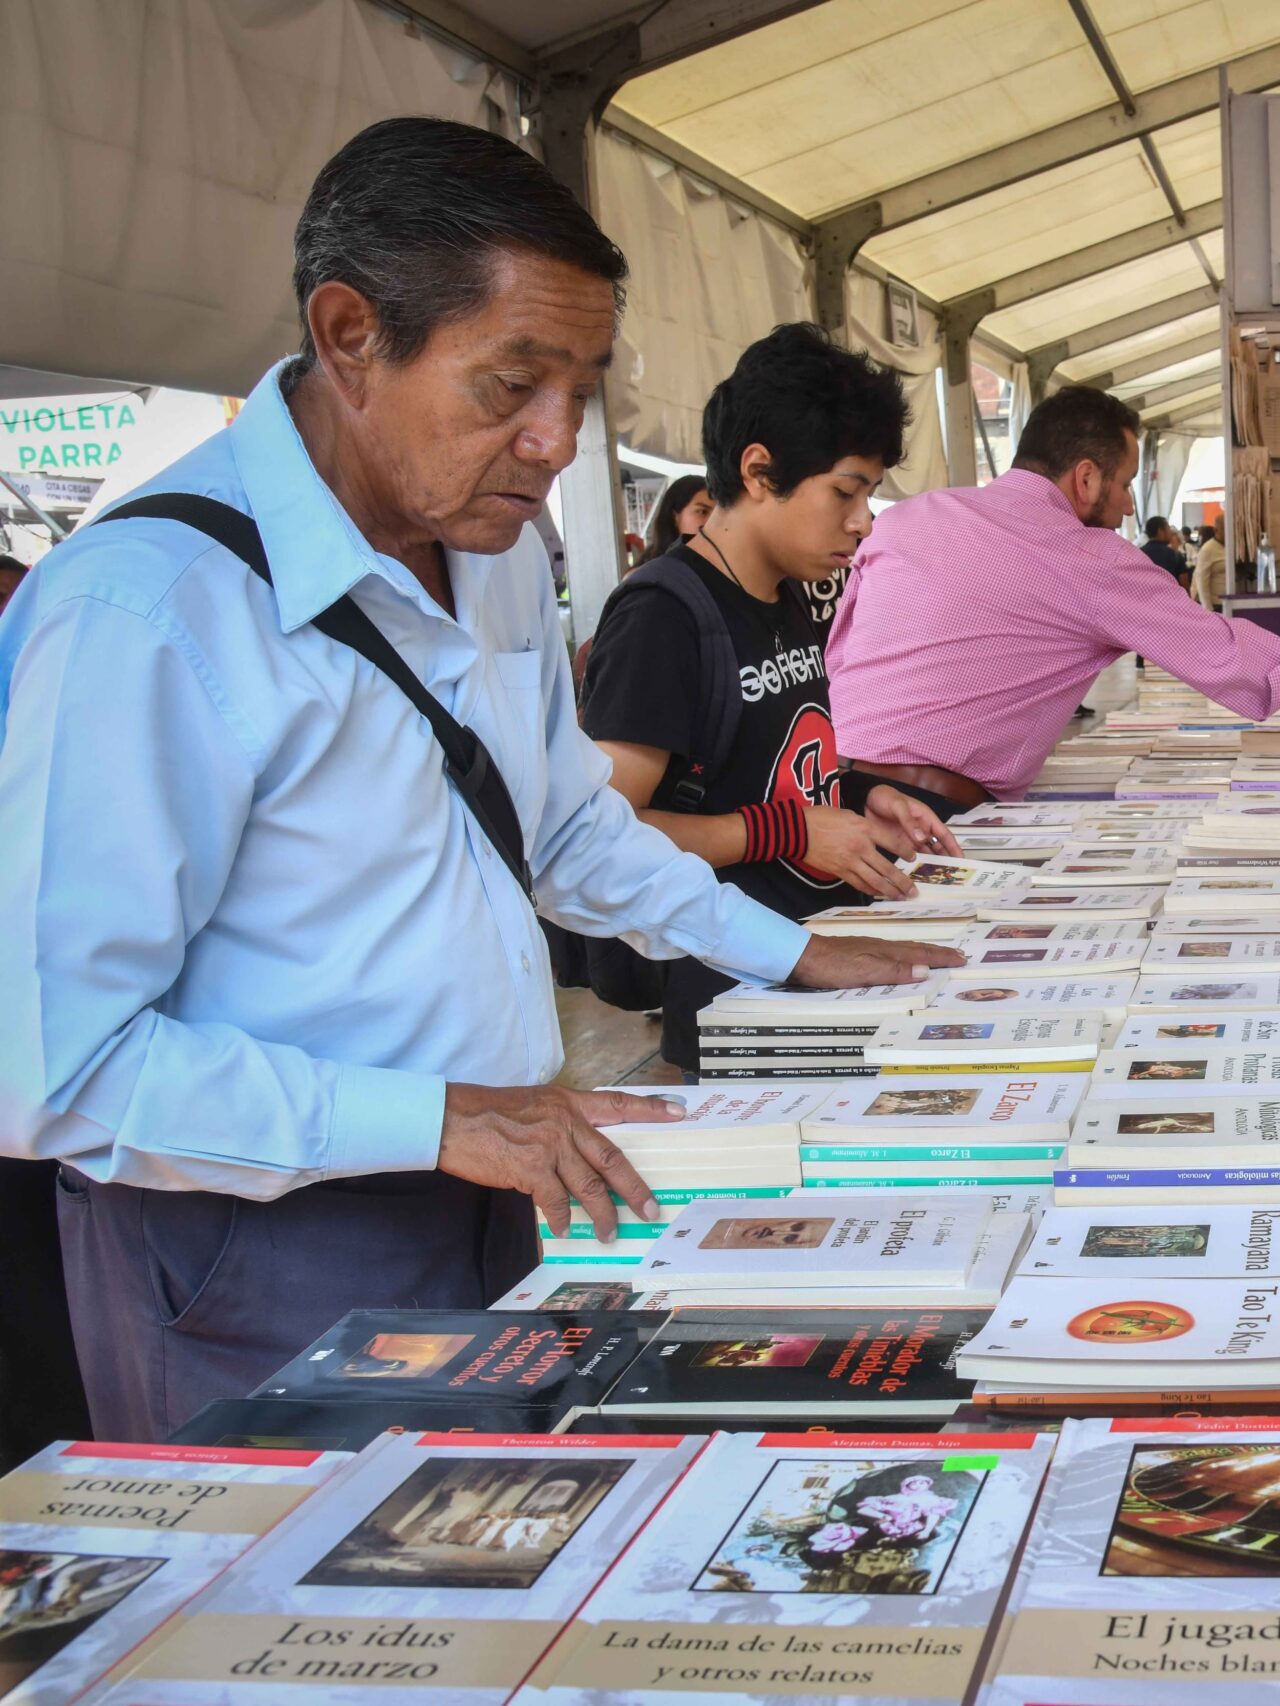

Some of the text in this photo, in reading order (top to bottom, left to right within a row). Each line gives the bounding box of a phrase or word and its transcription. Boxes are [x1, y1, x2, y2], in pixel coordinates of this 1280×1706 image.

[0, 404, 136, 434] VIOLETA
[18, 441, 123, 470] PARRA
[988, 1081, 1039, 1121] El Zarco
[931, 1149, 970, 1159] El Zarco
[1224, 1171, 1270, 1183] mitológicas
[880, 1209, 928, 1256] El profeta
[1215, 1286, 1279, 1355] Tao Te King
[486, 1326, 521, 1351] otros
[479, 1329, 556, 1385] Secreto y
[516, 1327, 594, 1387] El Horror
[848, 1333, 903, 1386] Tinieblas
[879, 1314, 945, 1393] El Morador de
[448, 1351, 498, 1388] cuentos
[558, 1437, 598, 1446] Wilder
[830, 1438, 961, 1448] Alejandro Dumas, hijo
[65, 1477, 228, 1505] de amor
[40, 1499, 196, 1528] Poemas
[272, 1622, 456, 1649] Los idus
[1101, 1614, 1148, 1639] El
[602, 1630, 963, 1657] La dama de las camelias
[230, 1650, 440, 1680] de marzo
[650, 1665, 875, 1685] y otros relatos
[1093, 1653, 1210, 1673] Noches
